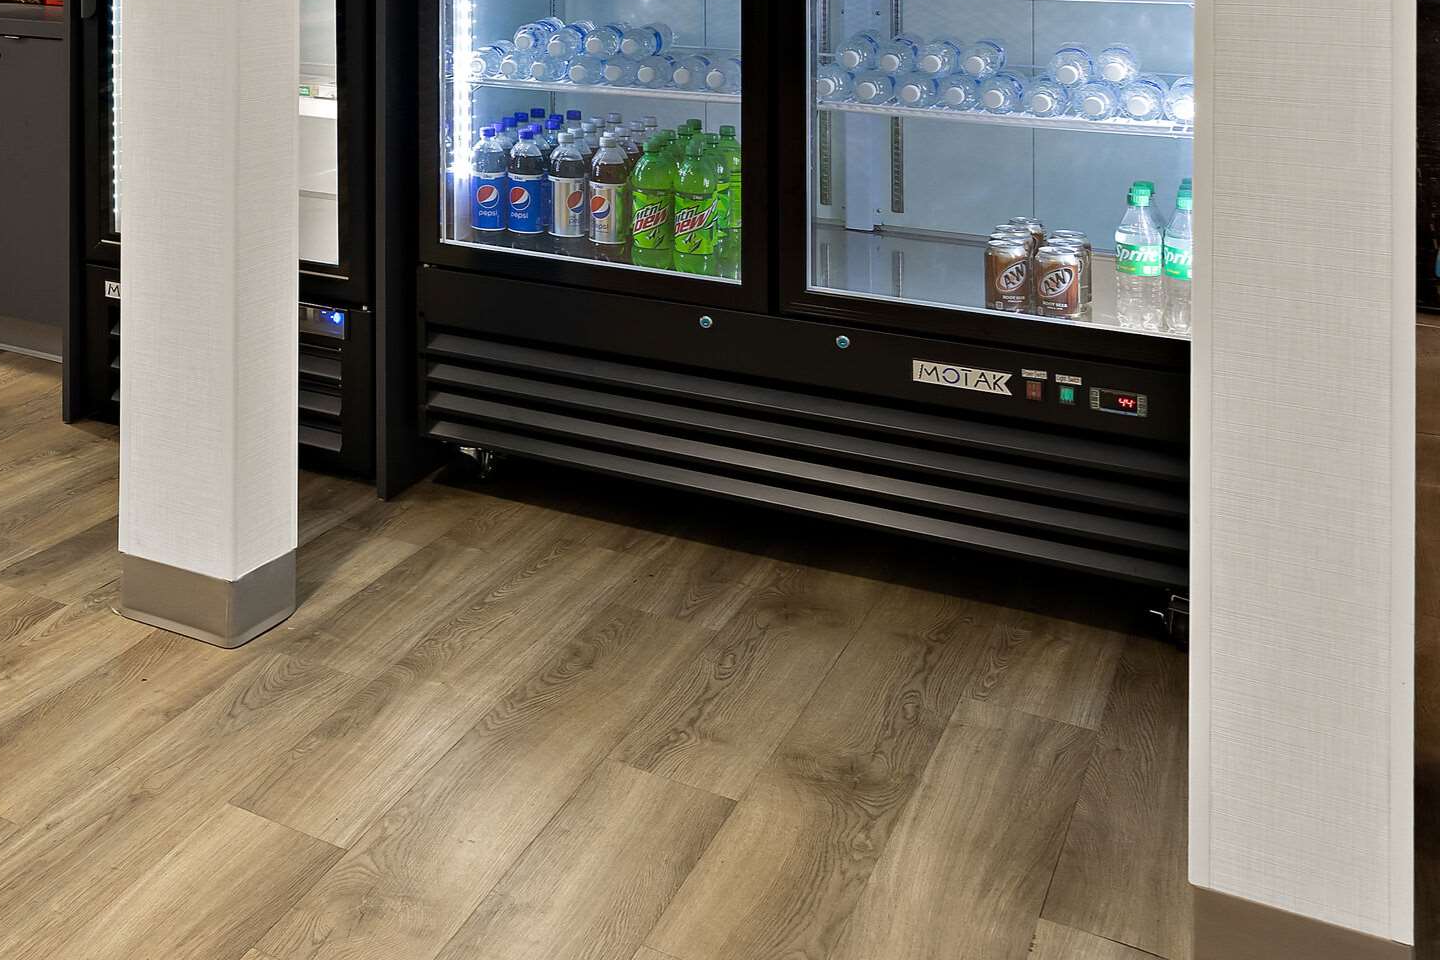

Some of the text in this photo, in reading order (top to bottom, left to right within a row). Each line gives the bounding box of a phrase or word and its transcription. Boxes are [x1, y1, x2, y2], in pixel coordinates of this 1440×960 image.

[479, 210, 498, 218] pepsi
[511, 210, 529, 220] pepsi
[918, 364, 1006, 392] MOTAK
